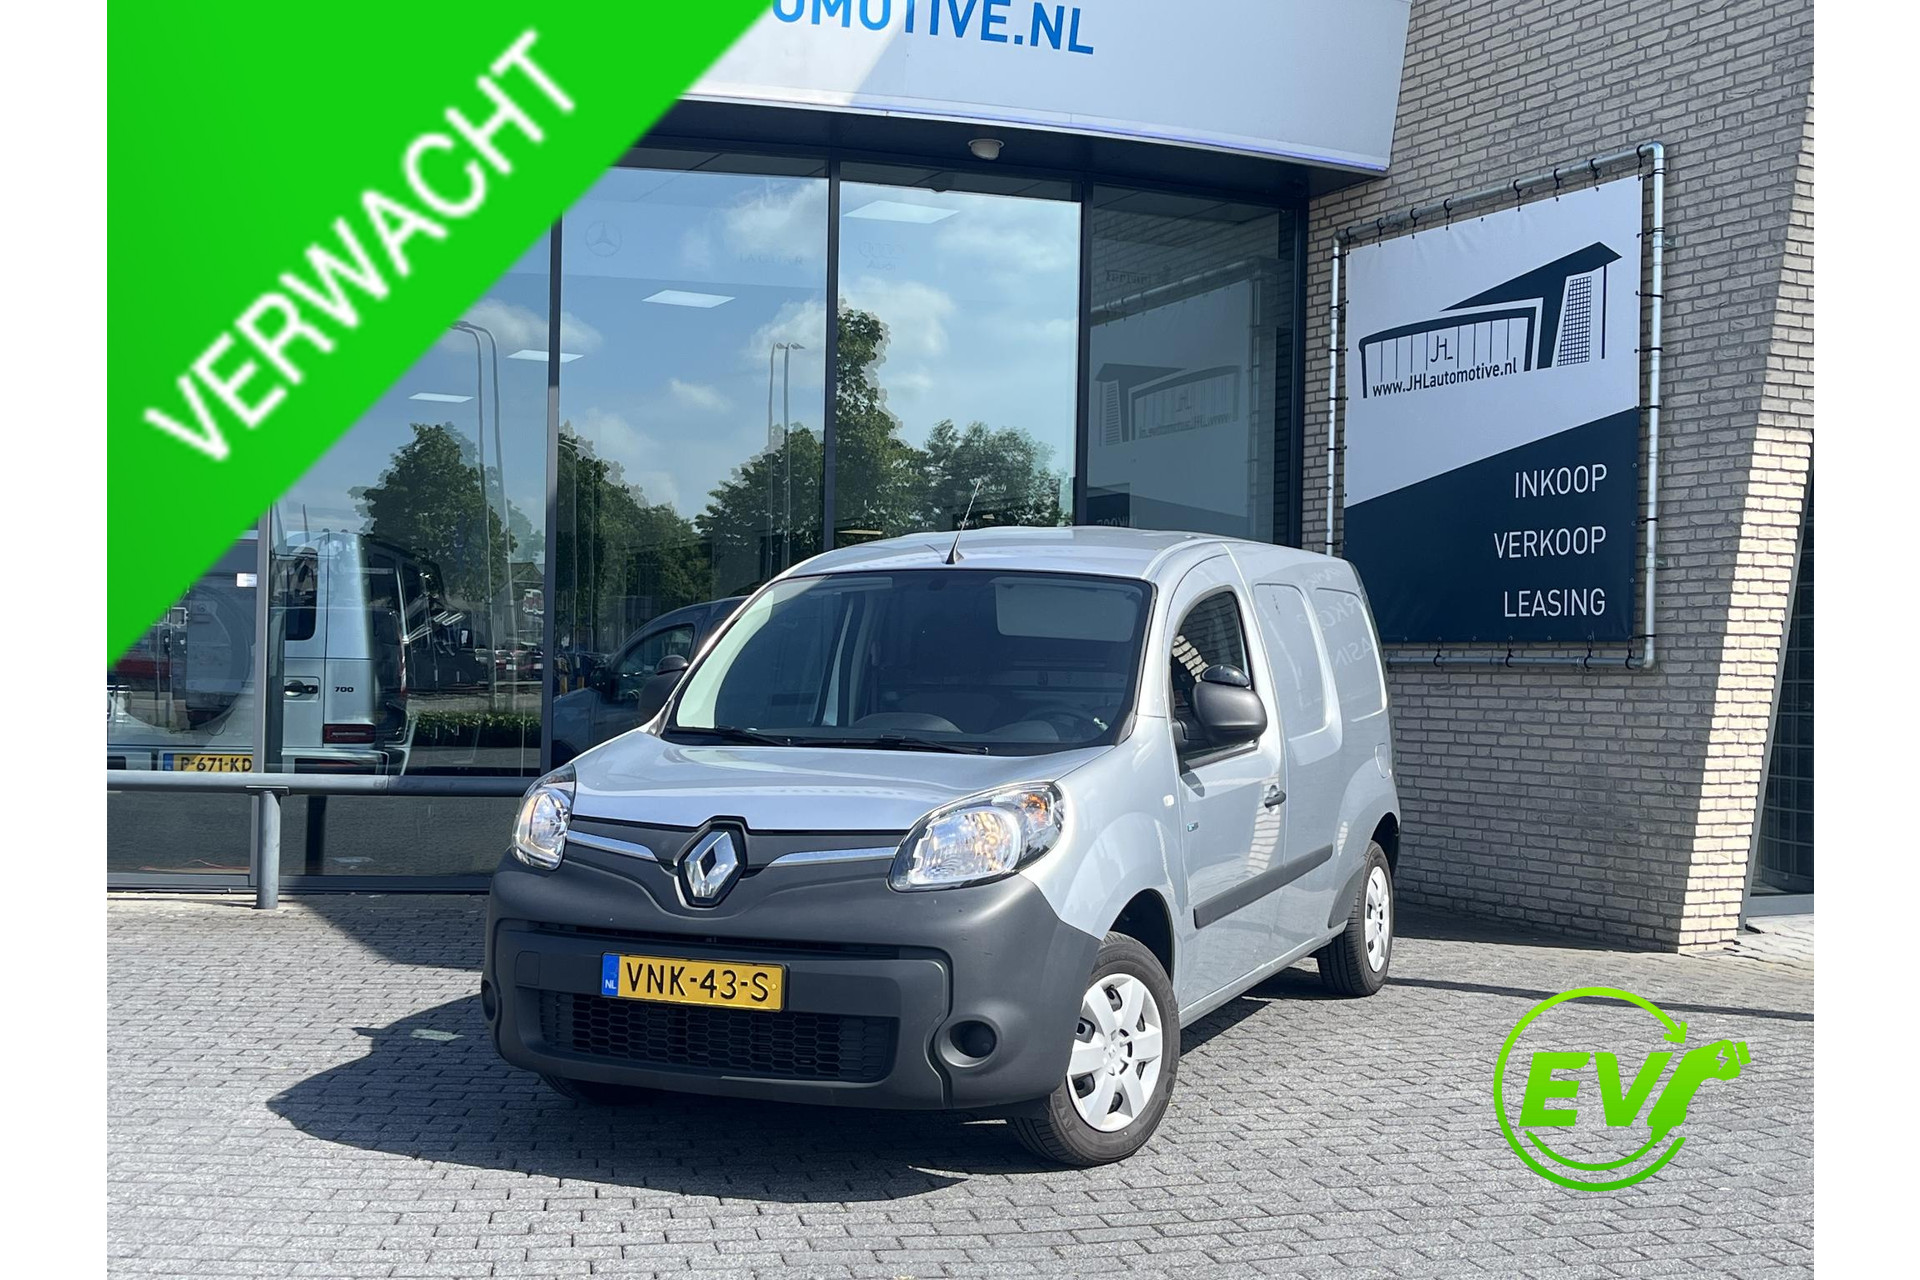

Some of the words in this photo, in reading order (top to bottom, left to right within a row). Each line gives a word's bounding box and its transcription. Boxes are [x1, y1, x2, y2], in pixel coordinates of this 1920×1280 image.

[1373, 357, 1517, 397] www.JHLautomotive.nl
[1515, 463, 1607, 498] INKOOP
[1494, 525, 1606, 559] VERKOOP
[1504, 588, 1605, 617] LEASING
[604, 979, 617, 990] NL
[626, 962, 769, 1002] VNK-43-S
